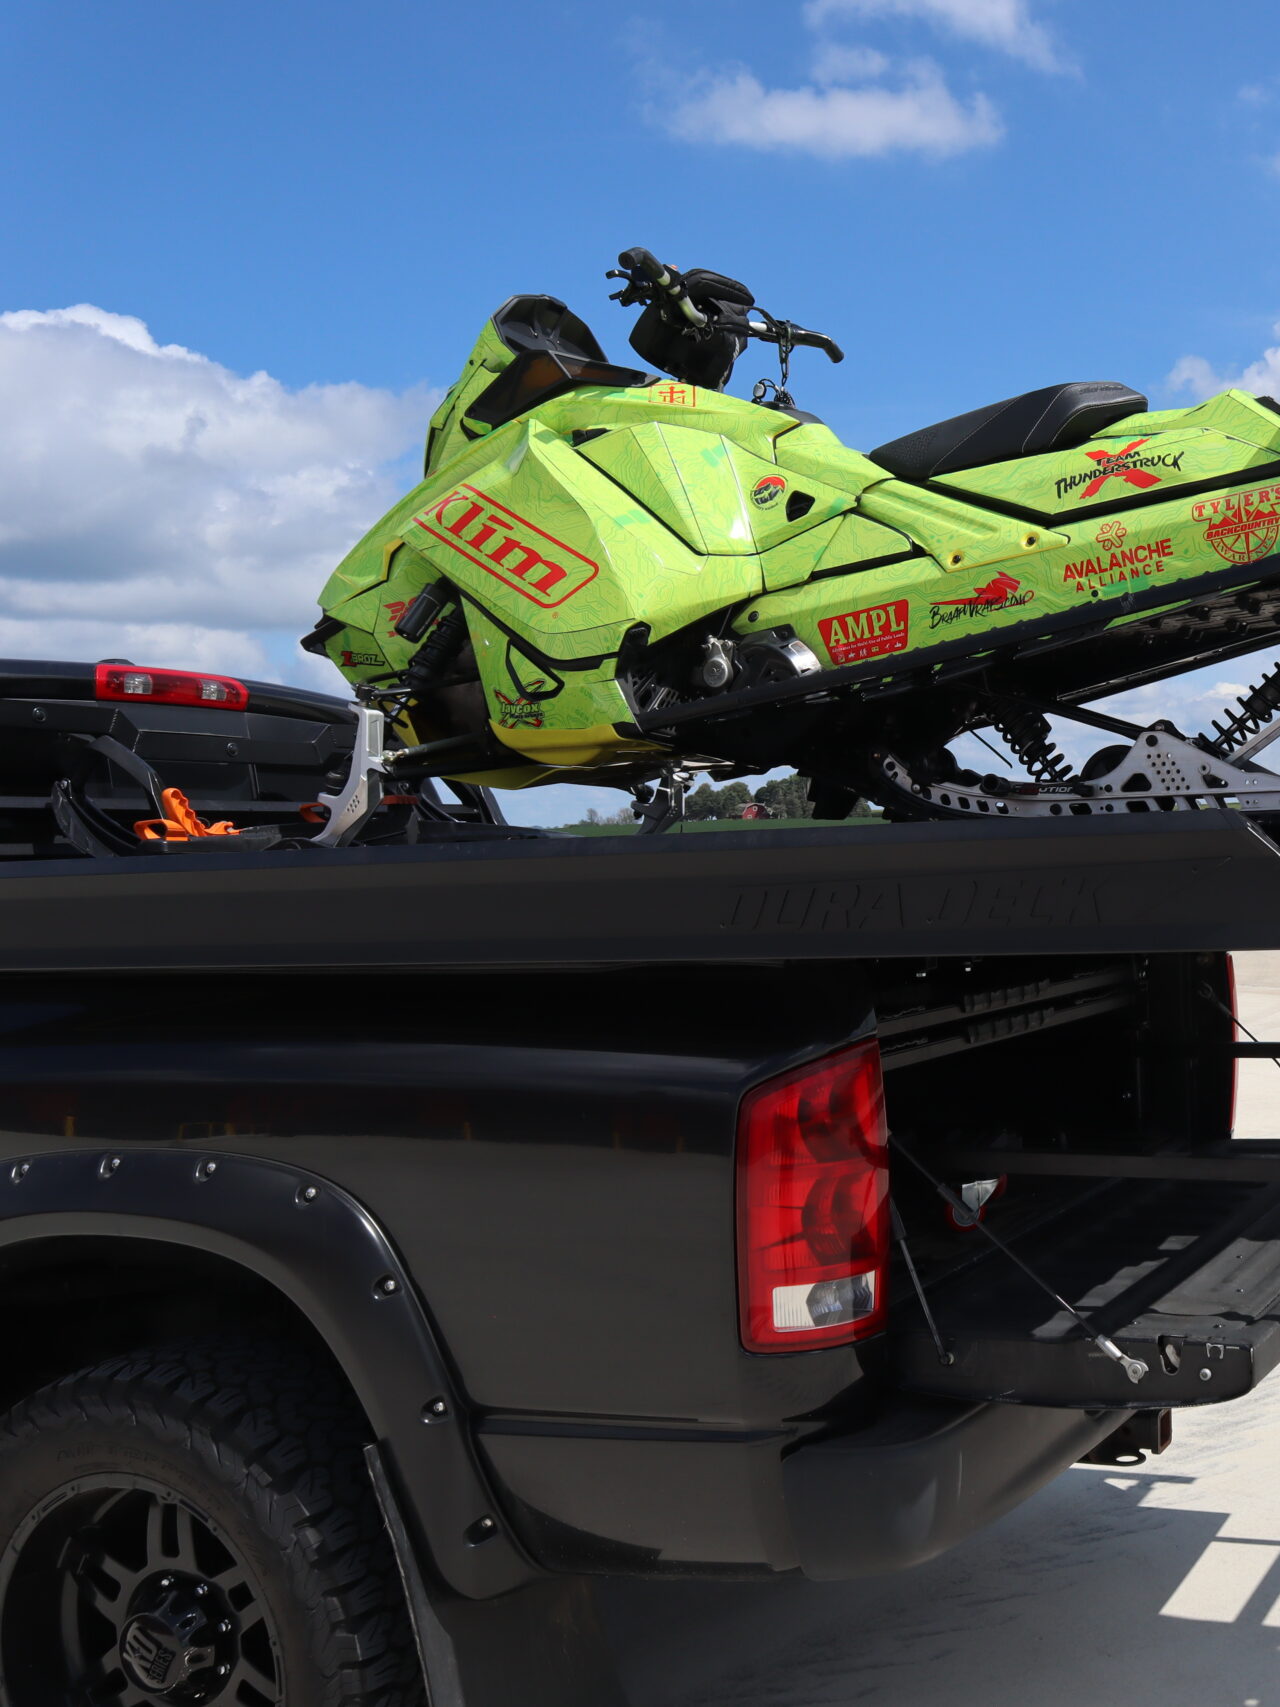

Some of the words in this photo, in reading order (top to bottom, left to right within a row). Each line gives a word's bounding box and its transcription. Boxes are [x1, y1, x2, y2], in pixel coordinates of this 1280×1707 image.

[1055, 451, 1185, 499] THUNDERSTRUCK
[1096, 450, 1141, 466] TEAM
[1206, 516, 1280, 540] BACKCOUNTRY
[1063, 538, 1174, 582] AVALANCHE
[1076, 560, 1165, 592] ALLIANCE
[829, 605, 905, 647] AMPL
